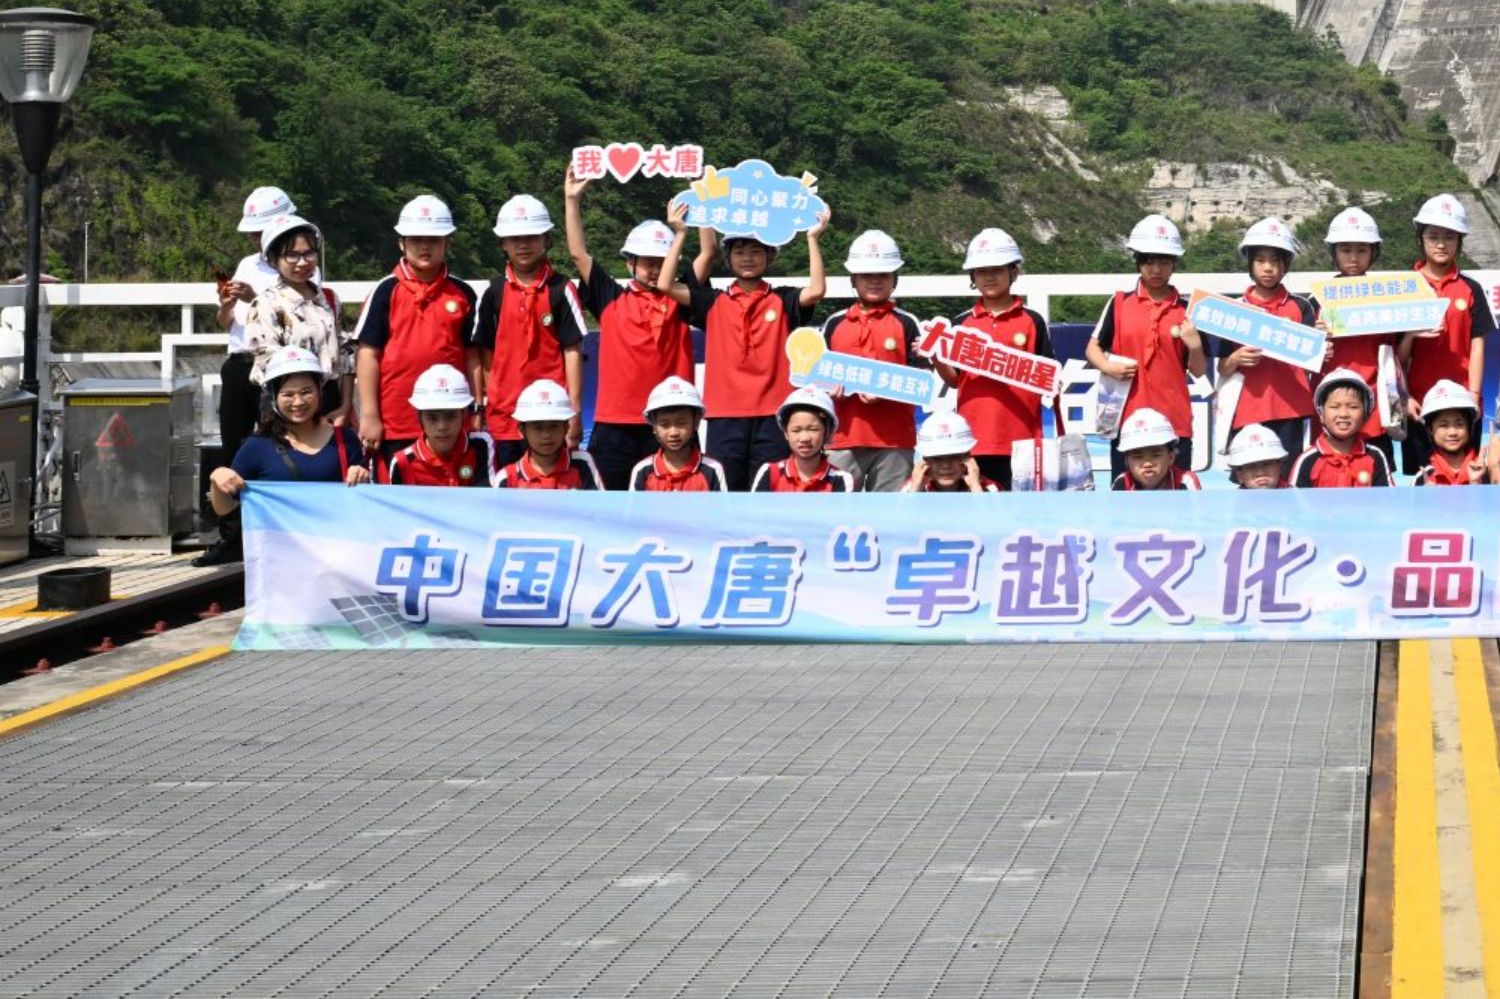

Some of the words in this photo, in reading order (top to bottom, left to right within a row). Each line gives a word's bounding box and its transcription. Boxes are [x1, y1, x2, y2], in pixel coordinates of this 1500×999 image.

[577, 149, 602, 174] 我
[646, 148, 699, 174] 大唐
[731, 188, 808, 210] 同心聚力
[690, 206, 769, 228] 追求卓越
[1323, 279, 1418, 300] 提供绿色能源
[919, 321, 1057, 391] 大唐启明星
[817, 361, 872, 385] 绿色低碳
[876, 371, 930, 397] 多能互补
